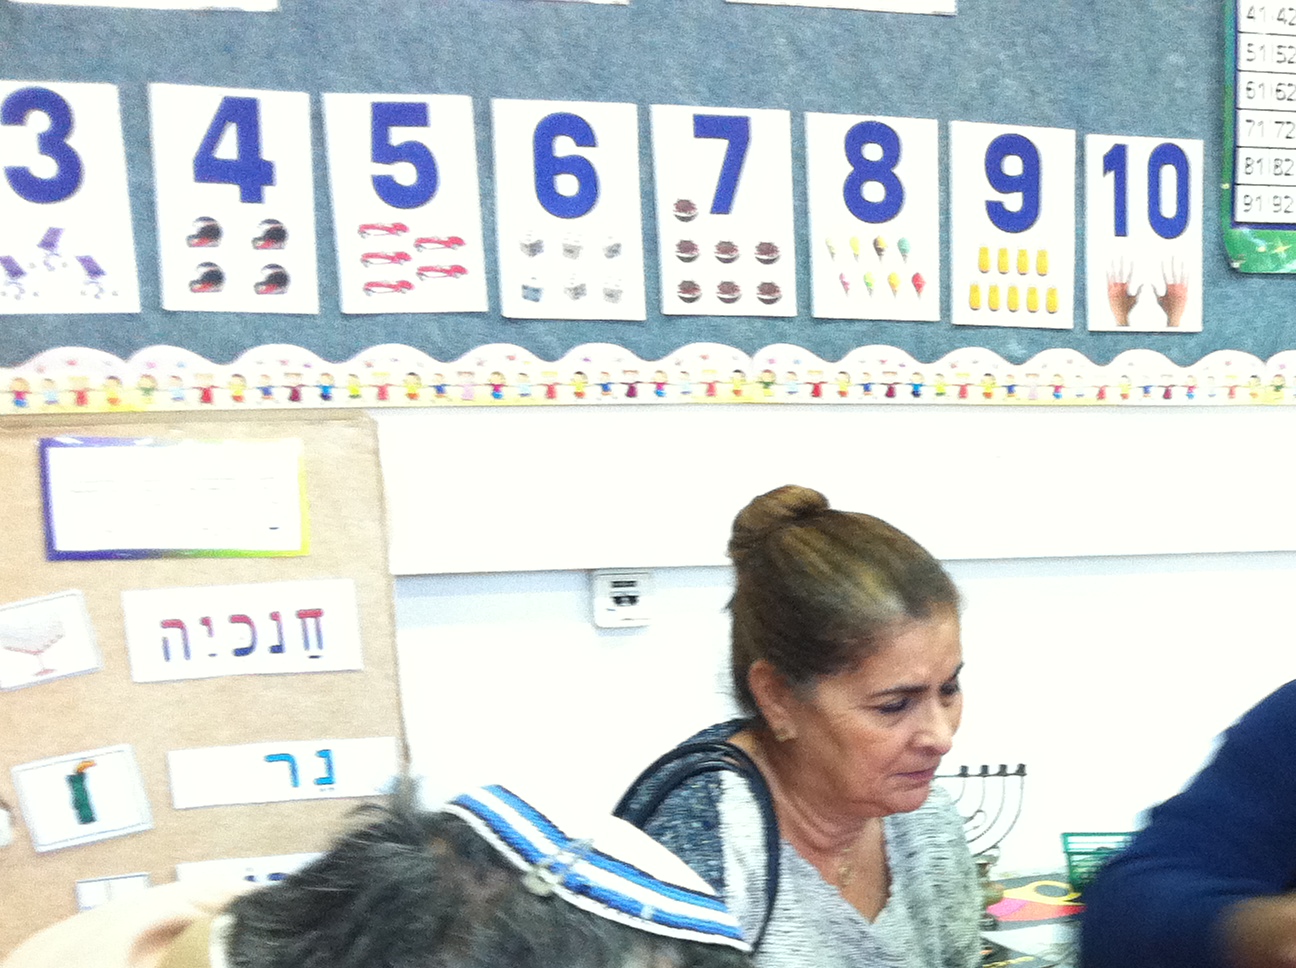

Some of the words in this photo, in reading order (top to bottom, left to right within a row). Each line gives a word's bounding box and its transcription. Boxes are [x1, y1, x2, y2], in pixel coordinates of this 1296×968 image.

[1246, 6, 1267, 27] 41
[1246, 43, 1267, 64] 51
[1245, 81, 1266, 102] 61
[1245, 119, 1266, 138] 71
[1274, 120, 1296, 140] 72
[1, 87, 83, 203] 3
[193, 97, 274, 203] 4
[371, 102, 439, 208] 5
[533, 112, 600, 218] 6
[692, 114, 750, 214] 7
[842, 121, 905, 223] 8
[984, 133, 1041, 233] 9
[1102, 142, 1190, 239] 10
[1244, 158, 1264, 177] 81
[1273, 158, 1295, 178] 82
[1242, 194, 1264, 214] 91
[1271, 195, 1295, 214] 92
